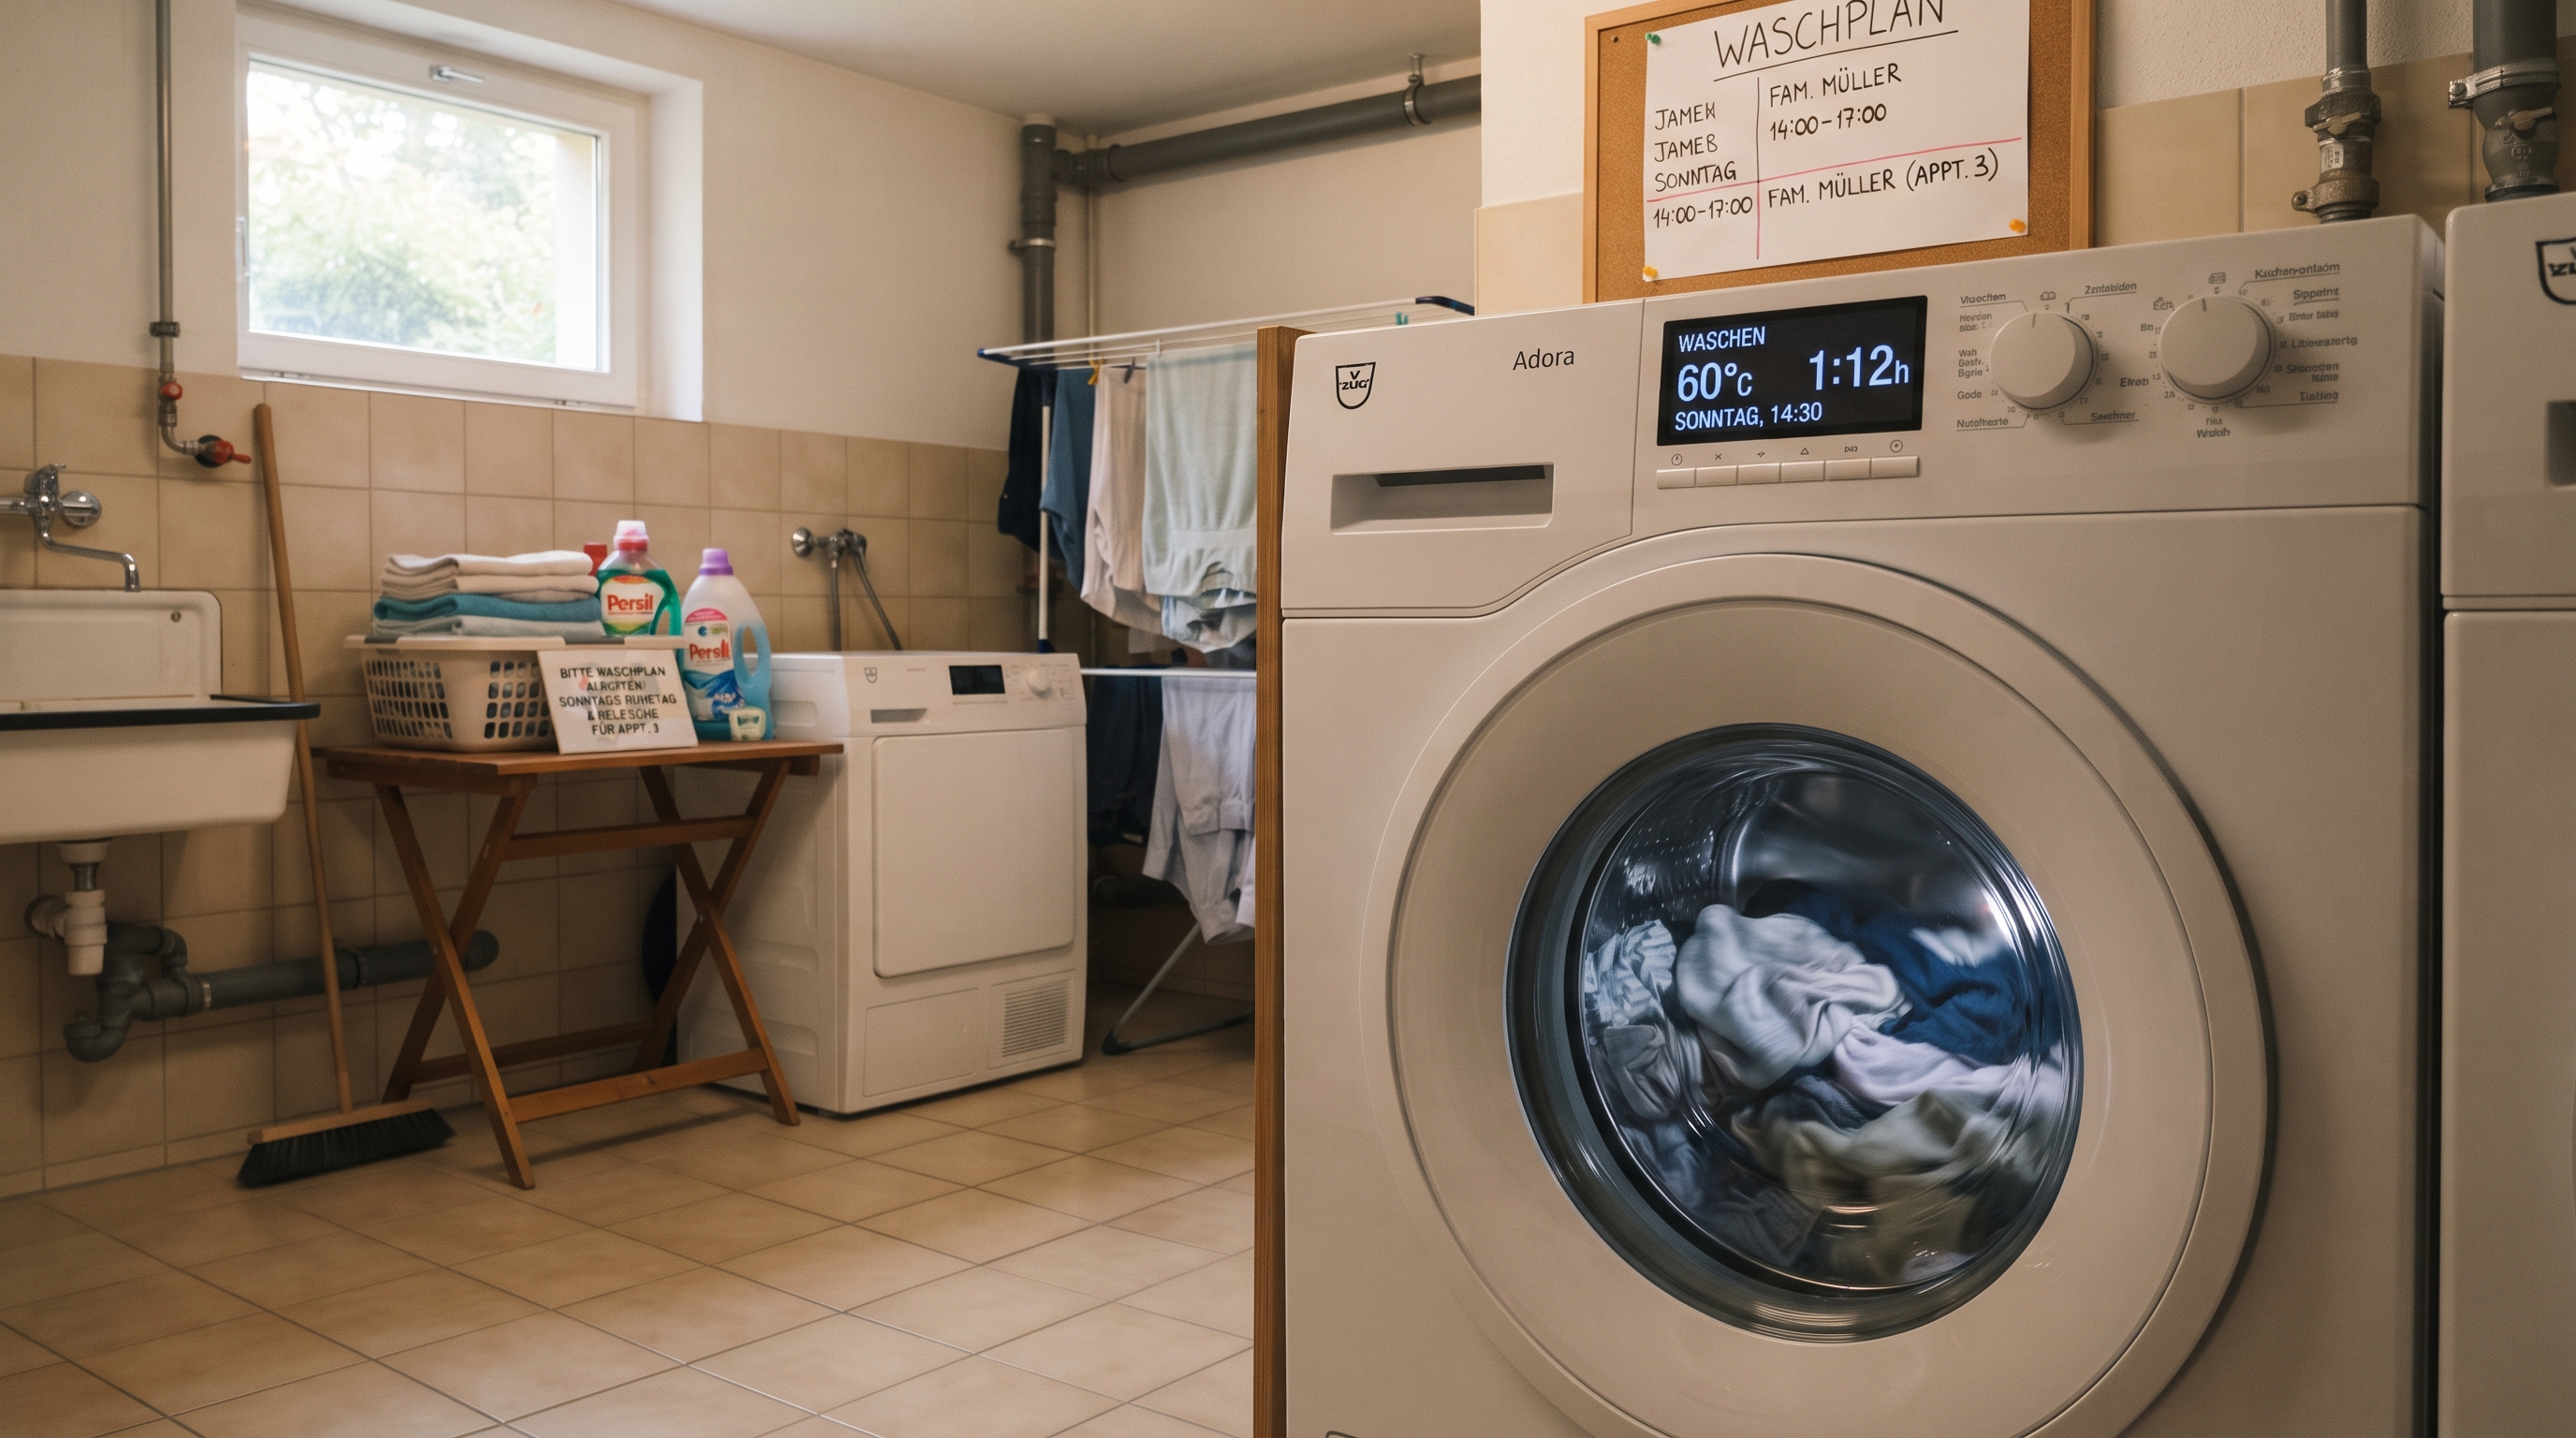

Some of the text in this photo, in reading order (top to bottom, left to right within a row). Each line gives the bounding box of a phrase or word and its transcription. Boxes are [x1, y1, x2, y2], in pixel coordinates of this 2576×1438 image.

[1713, 0, 1944, 68] WASCHPLAN
[1769, 62, 1902, 108] FAM. MÜLLER
[1654, 133, 1719, 163] JAMEB
[1654, 160, 1737, 193] SONNTAG
[1767, 147, 2000, 209] FAM. MÜLLER (APPT. 3)
[1652, 195, 1754, 229] 14:00-17:00
[1678, 326, 1766, 353] WASCHEN
[1512, 347, 1575, 372] Adora
[1676, 345, 1910, 403] 60°C 1:12h
[1675, 402, 1823, 432] SONNTAG, 14:30
[607, 593, 653, 611] Persil
[561, 666, 666, 678] BITTE WASCHPLAN
[559, 694, 677, 707] SONNTAGS RUHETAG
[592, 723, 615, 735] FÜR
